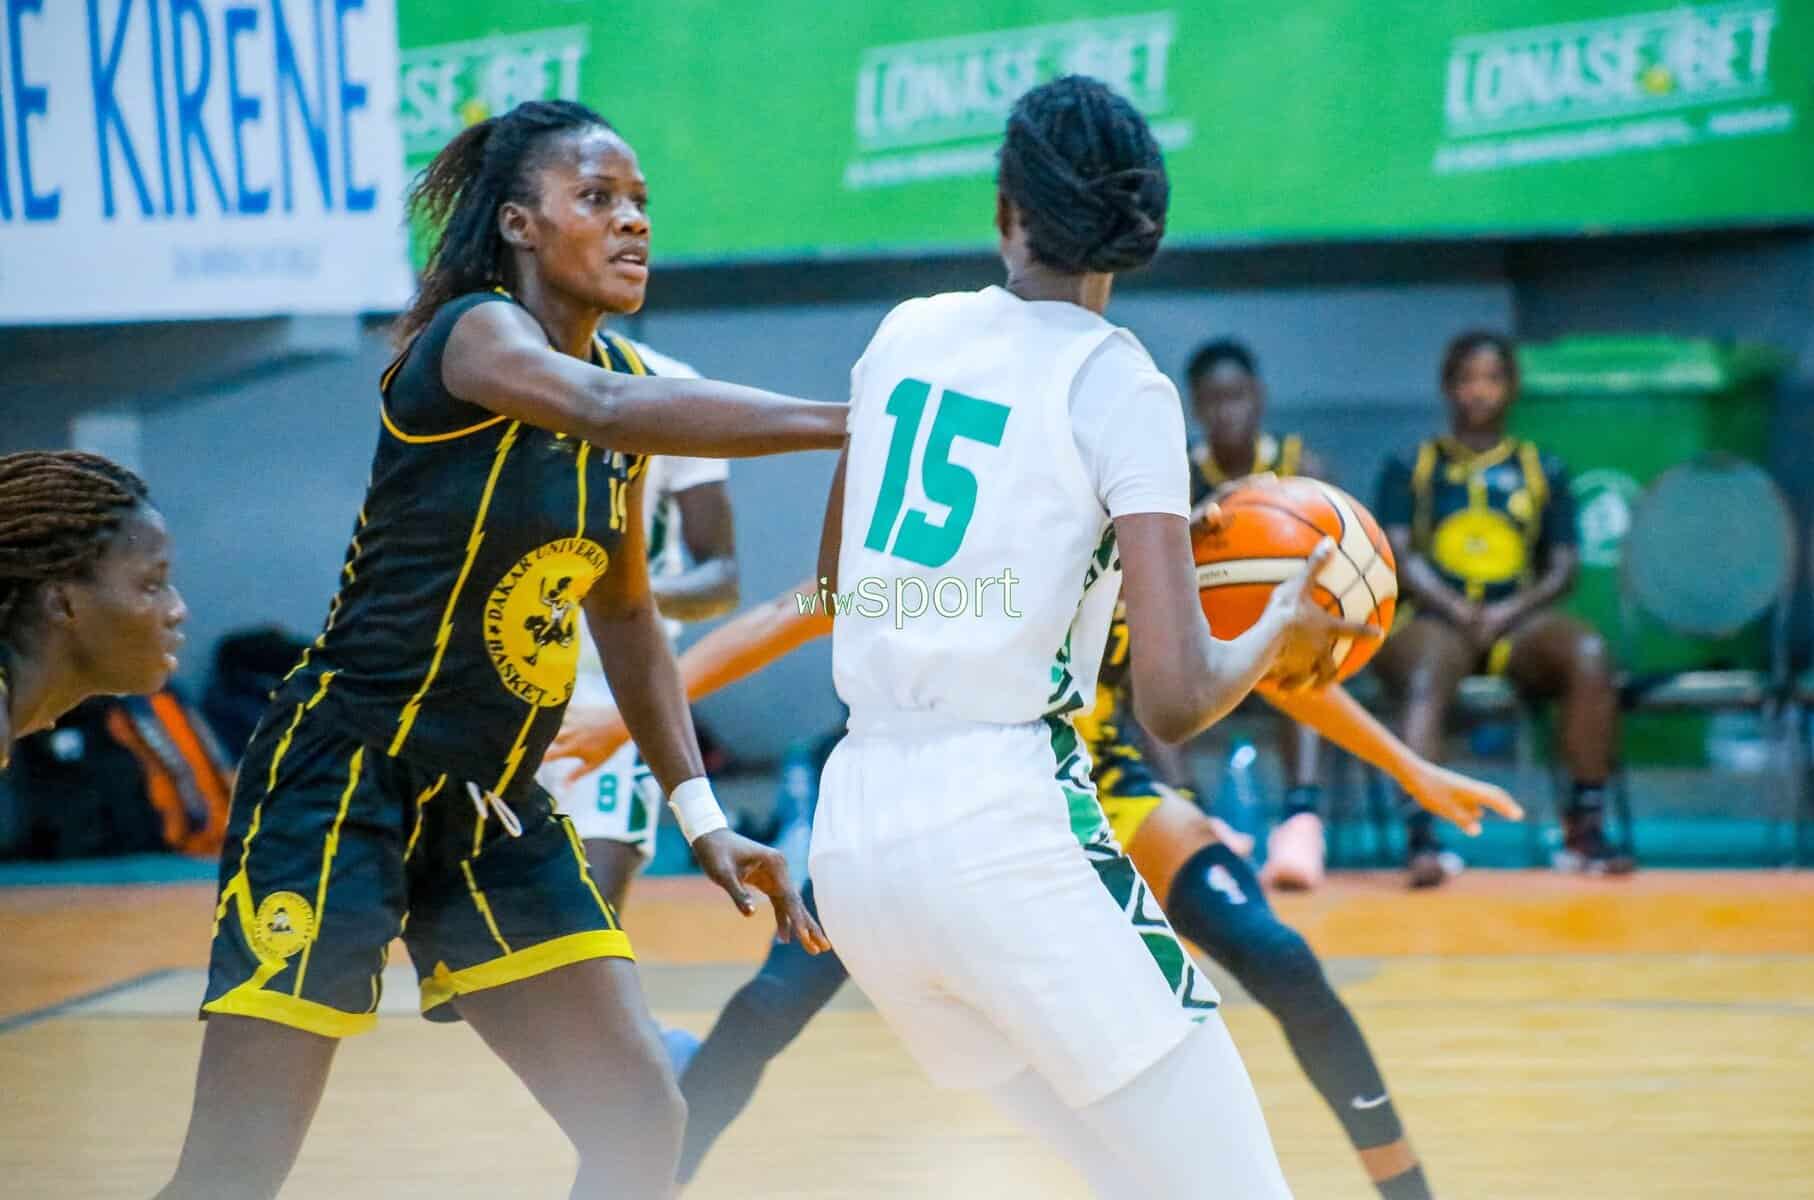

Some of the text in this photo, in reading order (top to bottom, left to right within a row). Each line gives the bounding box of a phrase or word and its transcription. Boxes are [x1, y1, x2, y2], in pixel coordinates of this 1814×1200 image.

[0, 0, 380, 221] E KIRENE
[864, 377, 1012, 568] 15
[487, 556, 533, 621] DAKAR
[597, 772, 619, 813] 8
